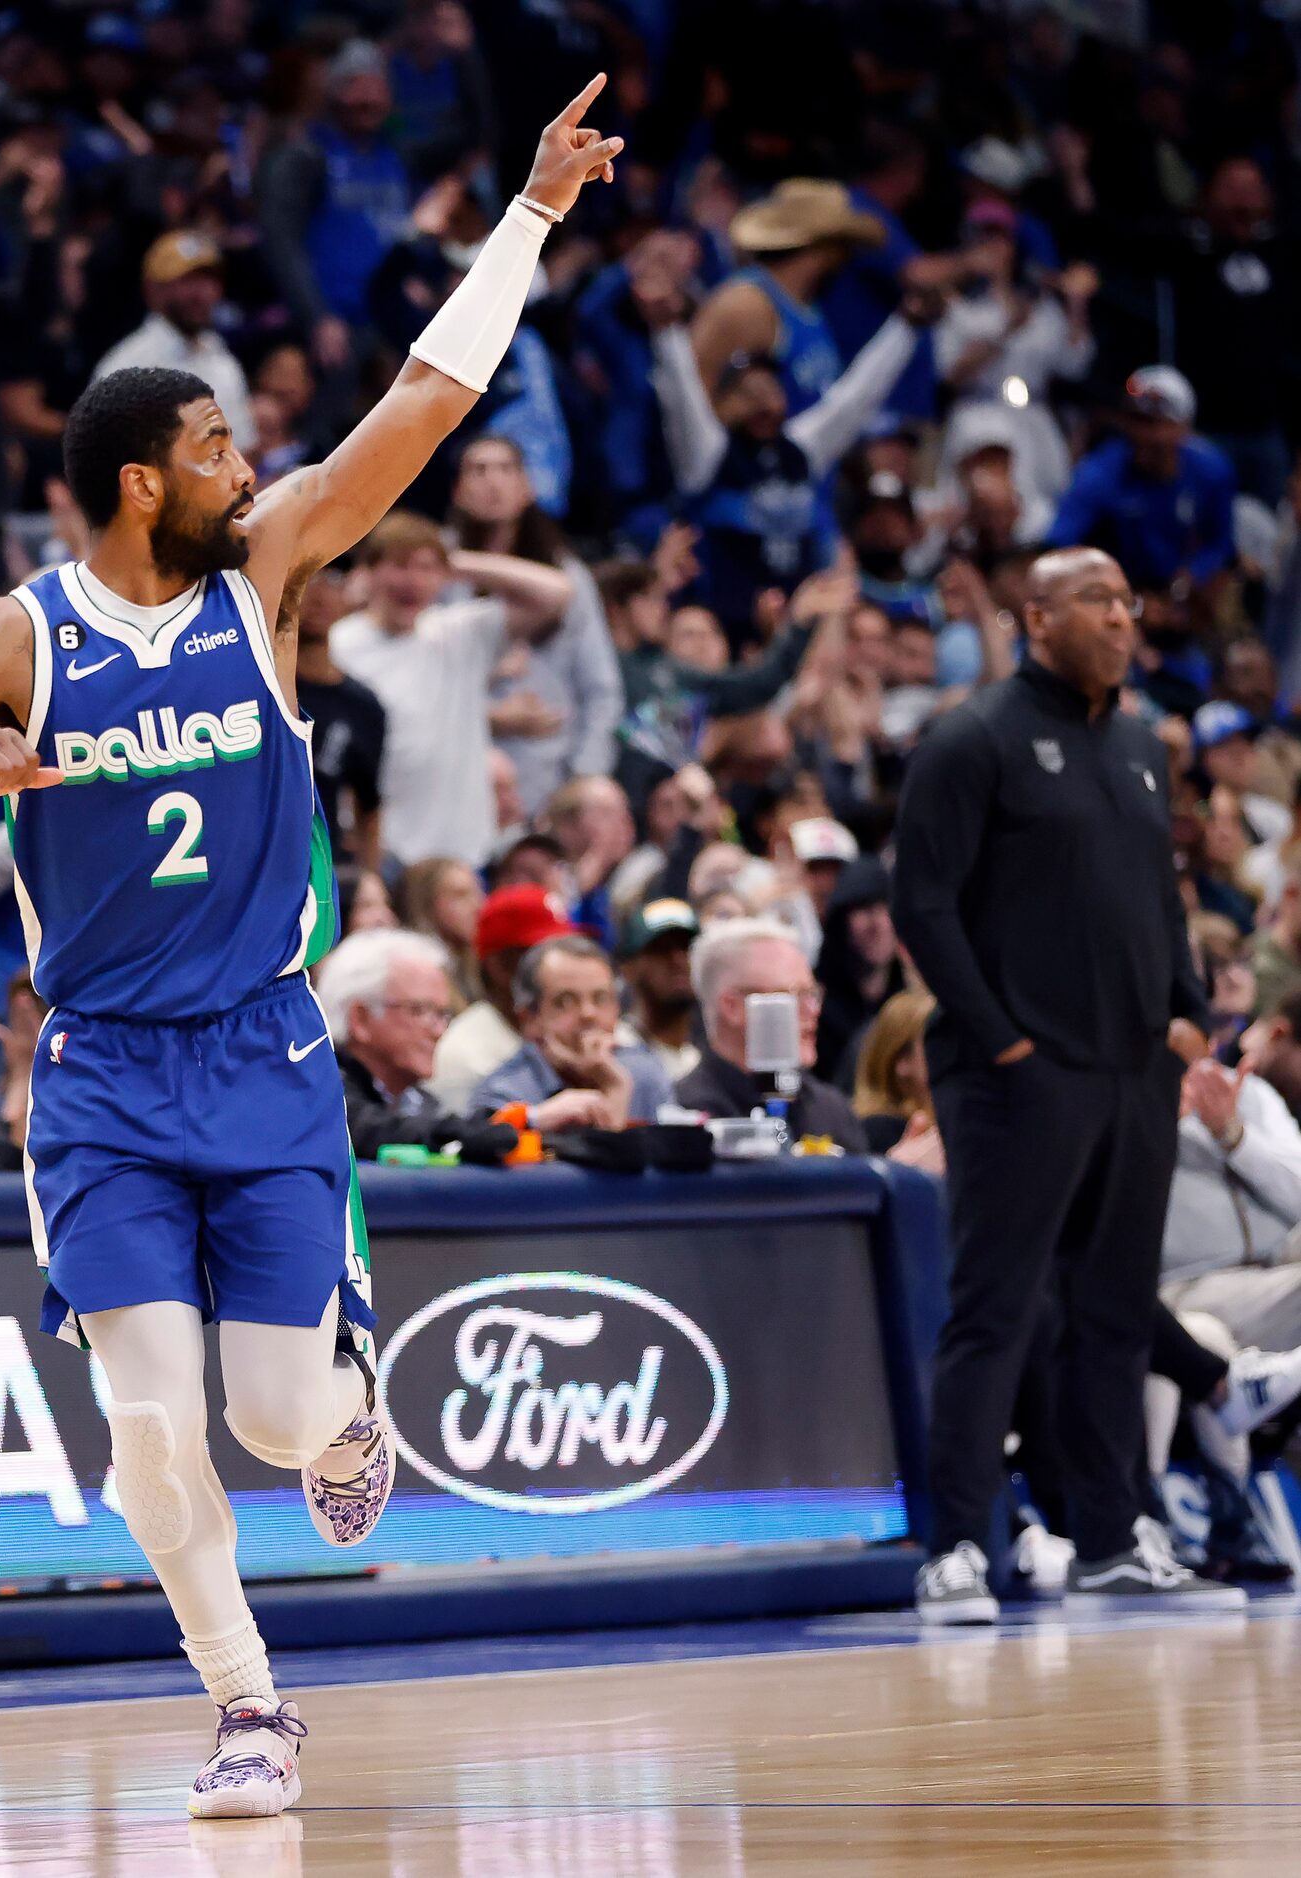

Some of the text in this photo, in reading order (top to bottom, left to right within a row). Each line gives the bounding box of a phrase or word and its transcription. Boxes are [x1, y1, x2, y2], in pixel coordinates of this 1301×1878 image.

[58, 625, 79, 650] 6
[184, 628, 239, 656] chime
[148, 791, 209, 887] 2
[441, 1305, 668, 1471] Ford
